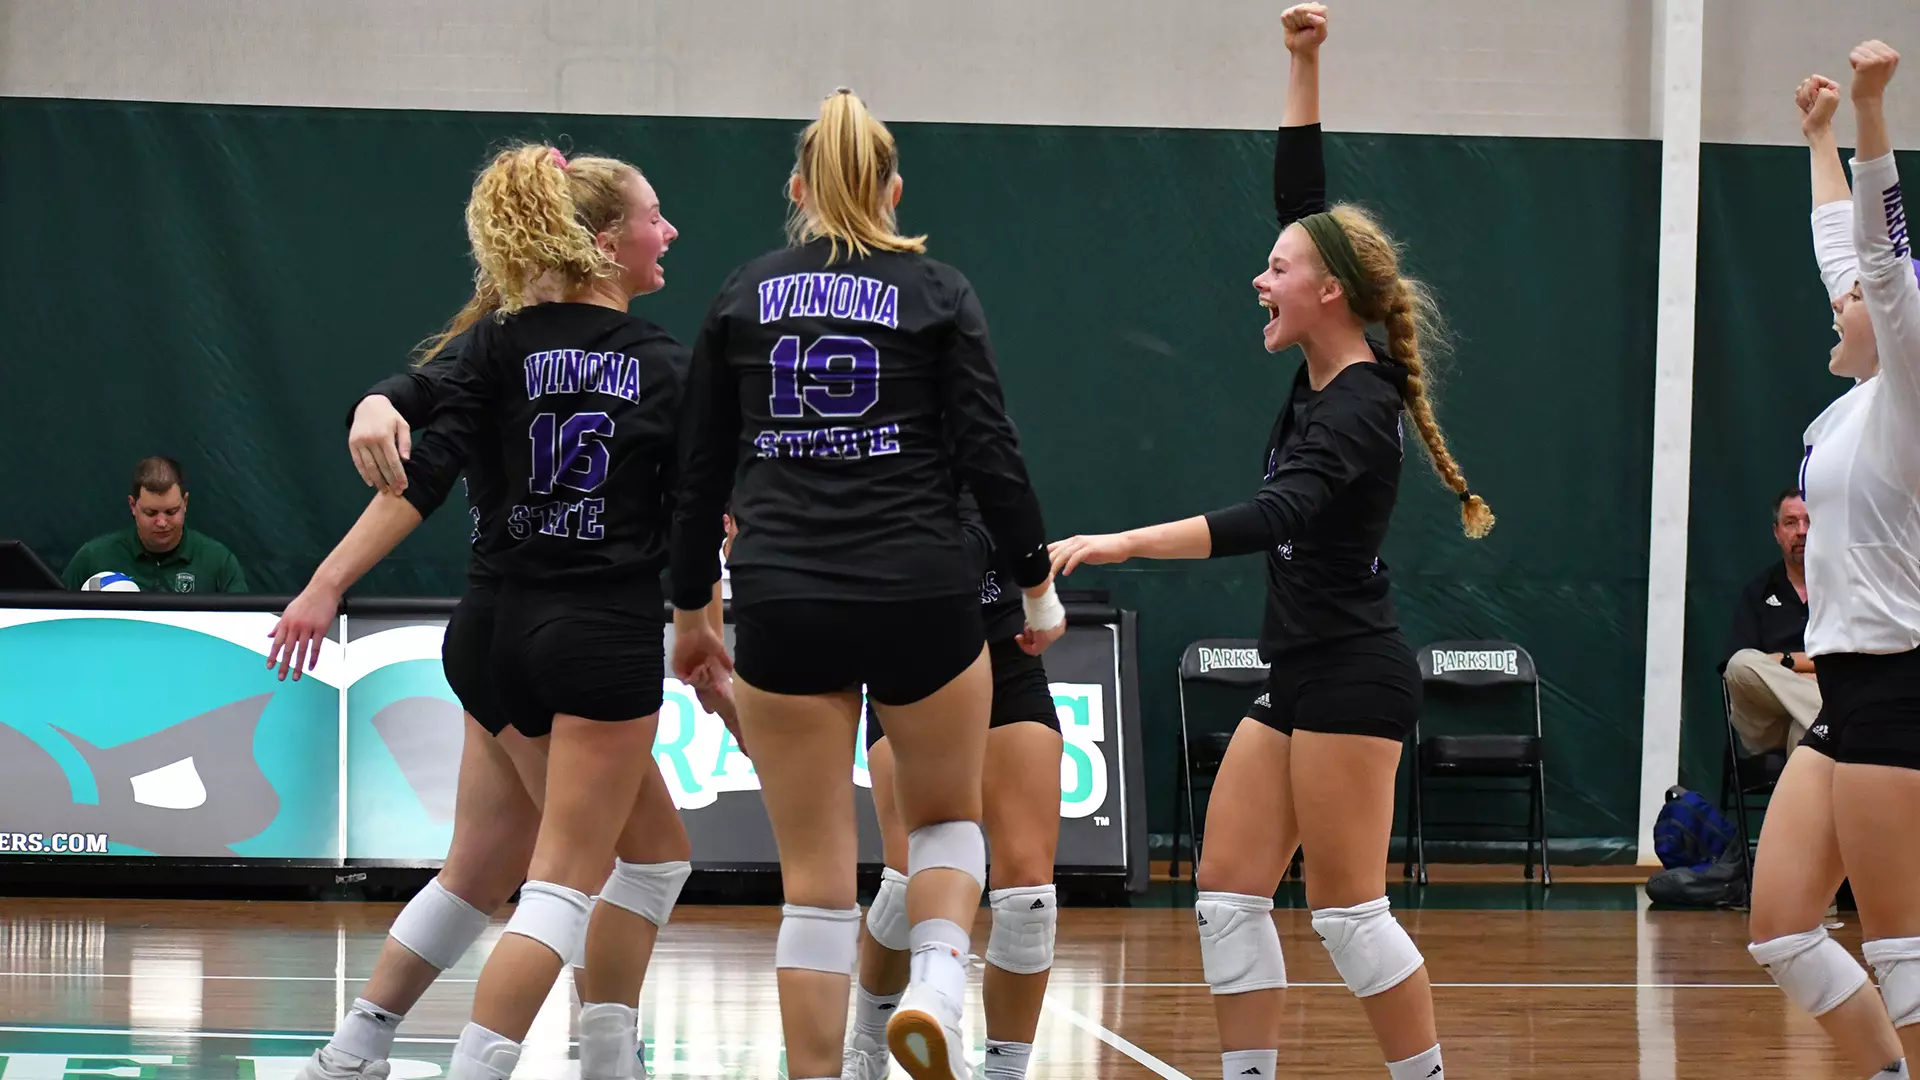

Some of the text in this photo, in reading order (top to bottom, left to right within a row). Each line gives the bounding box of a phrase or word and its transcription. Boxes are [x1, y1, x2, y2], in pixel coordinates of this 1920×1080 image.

[757, 271, 900, 330] WINONA
[523, 348, 641, 405] WINONA
[768, 334, 881, 418] 19
[528, 411, 616, 494] 16
[753, 423, 901, 460] STATE
[1431, 649, 1519, 675] PARKSIDE
[1093, 815, 1111, 827] TM
